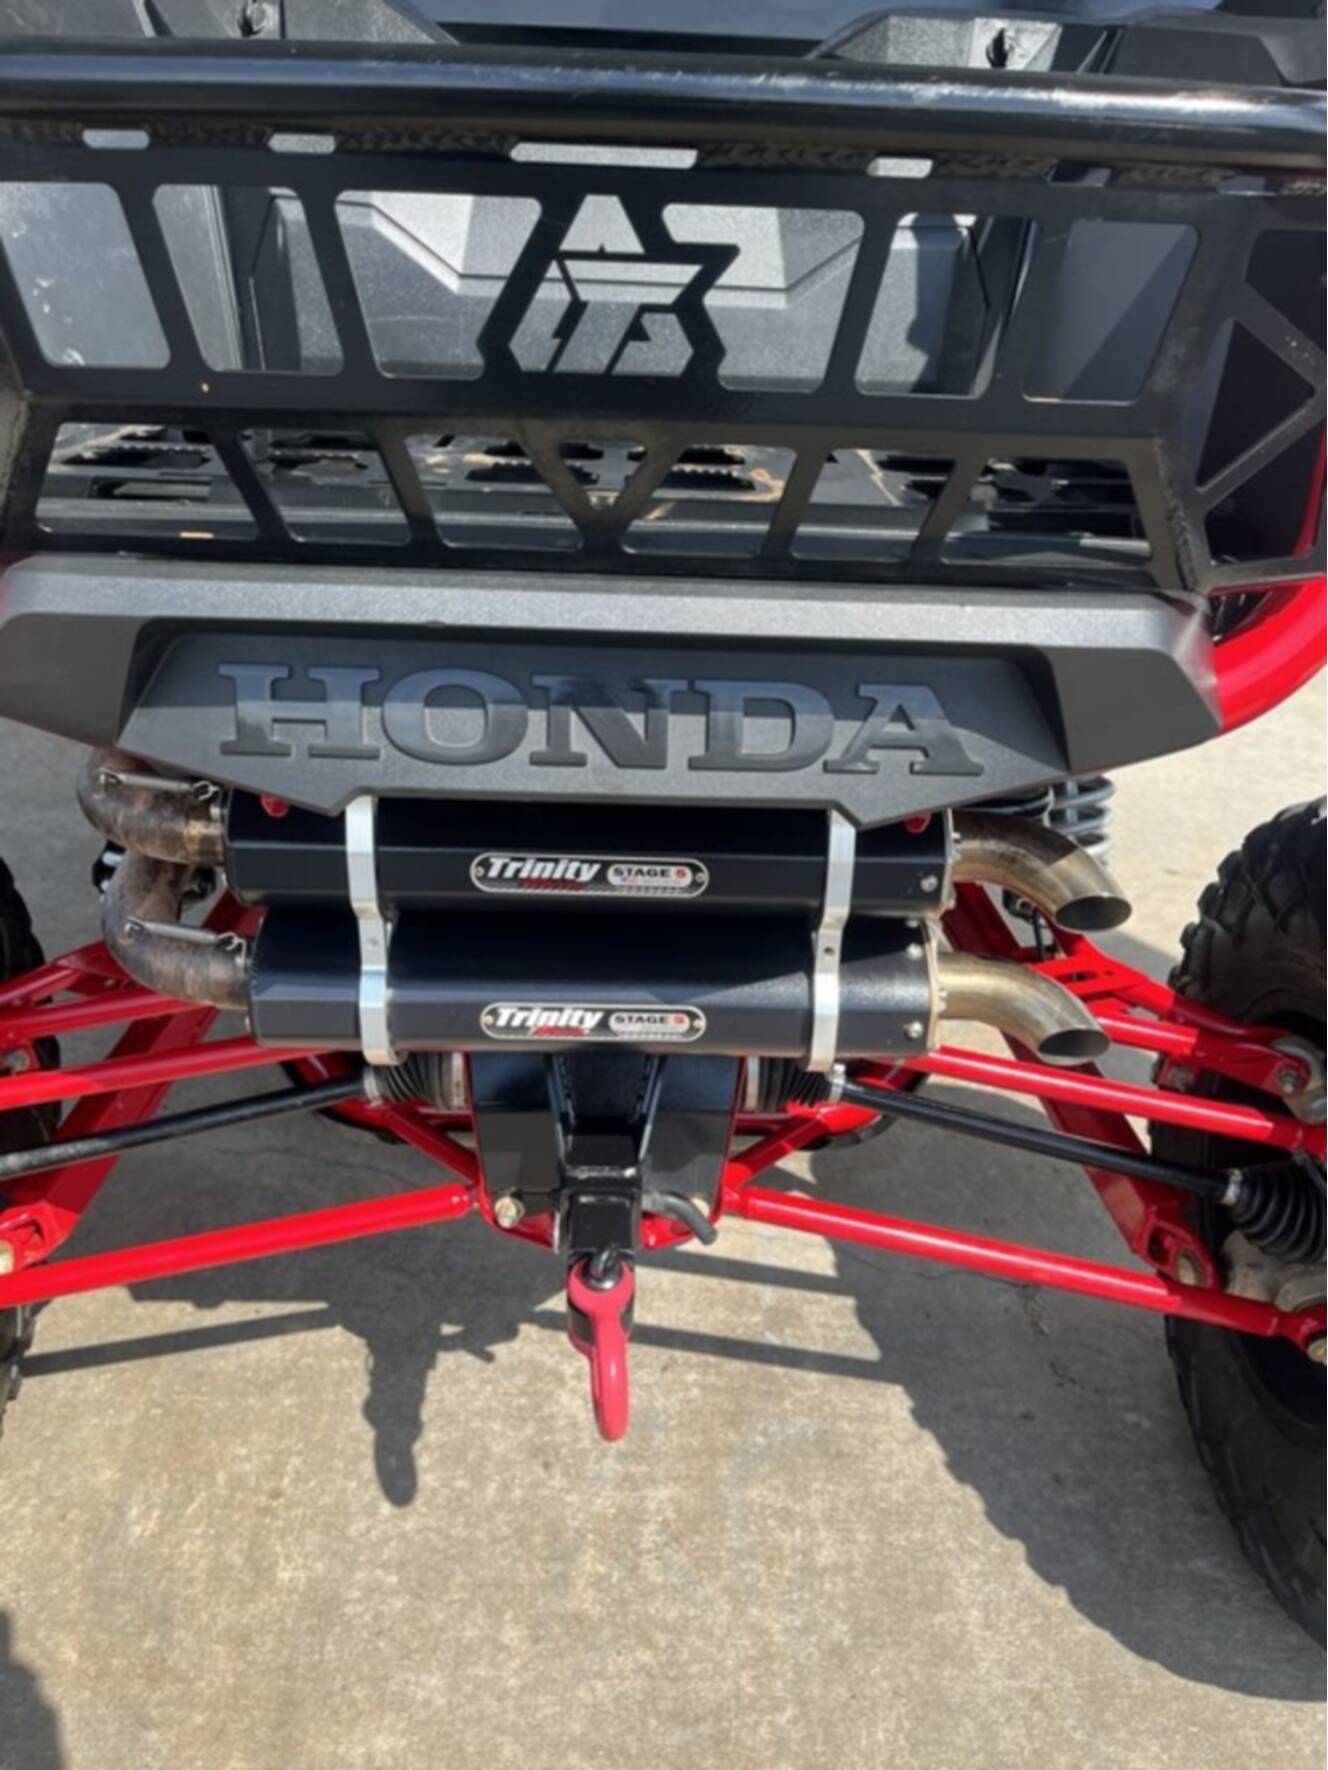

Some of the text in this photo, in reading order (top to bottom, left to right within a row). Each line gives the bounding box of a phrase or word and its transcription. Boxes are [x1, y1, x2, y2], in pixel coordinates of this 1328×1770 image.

[217, 664, 985, 776] HONDA
[487, 857, 600, 882] Trinity
[613, 866, 671, 878] STAGE
[495, 1007, 605, 1029] Trinity
[614, 1014, 668, 1025] STAGE
